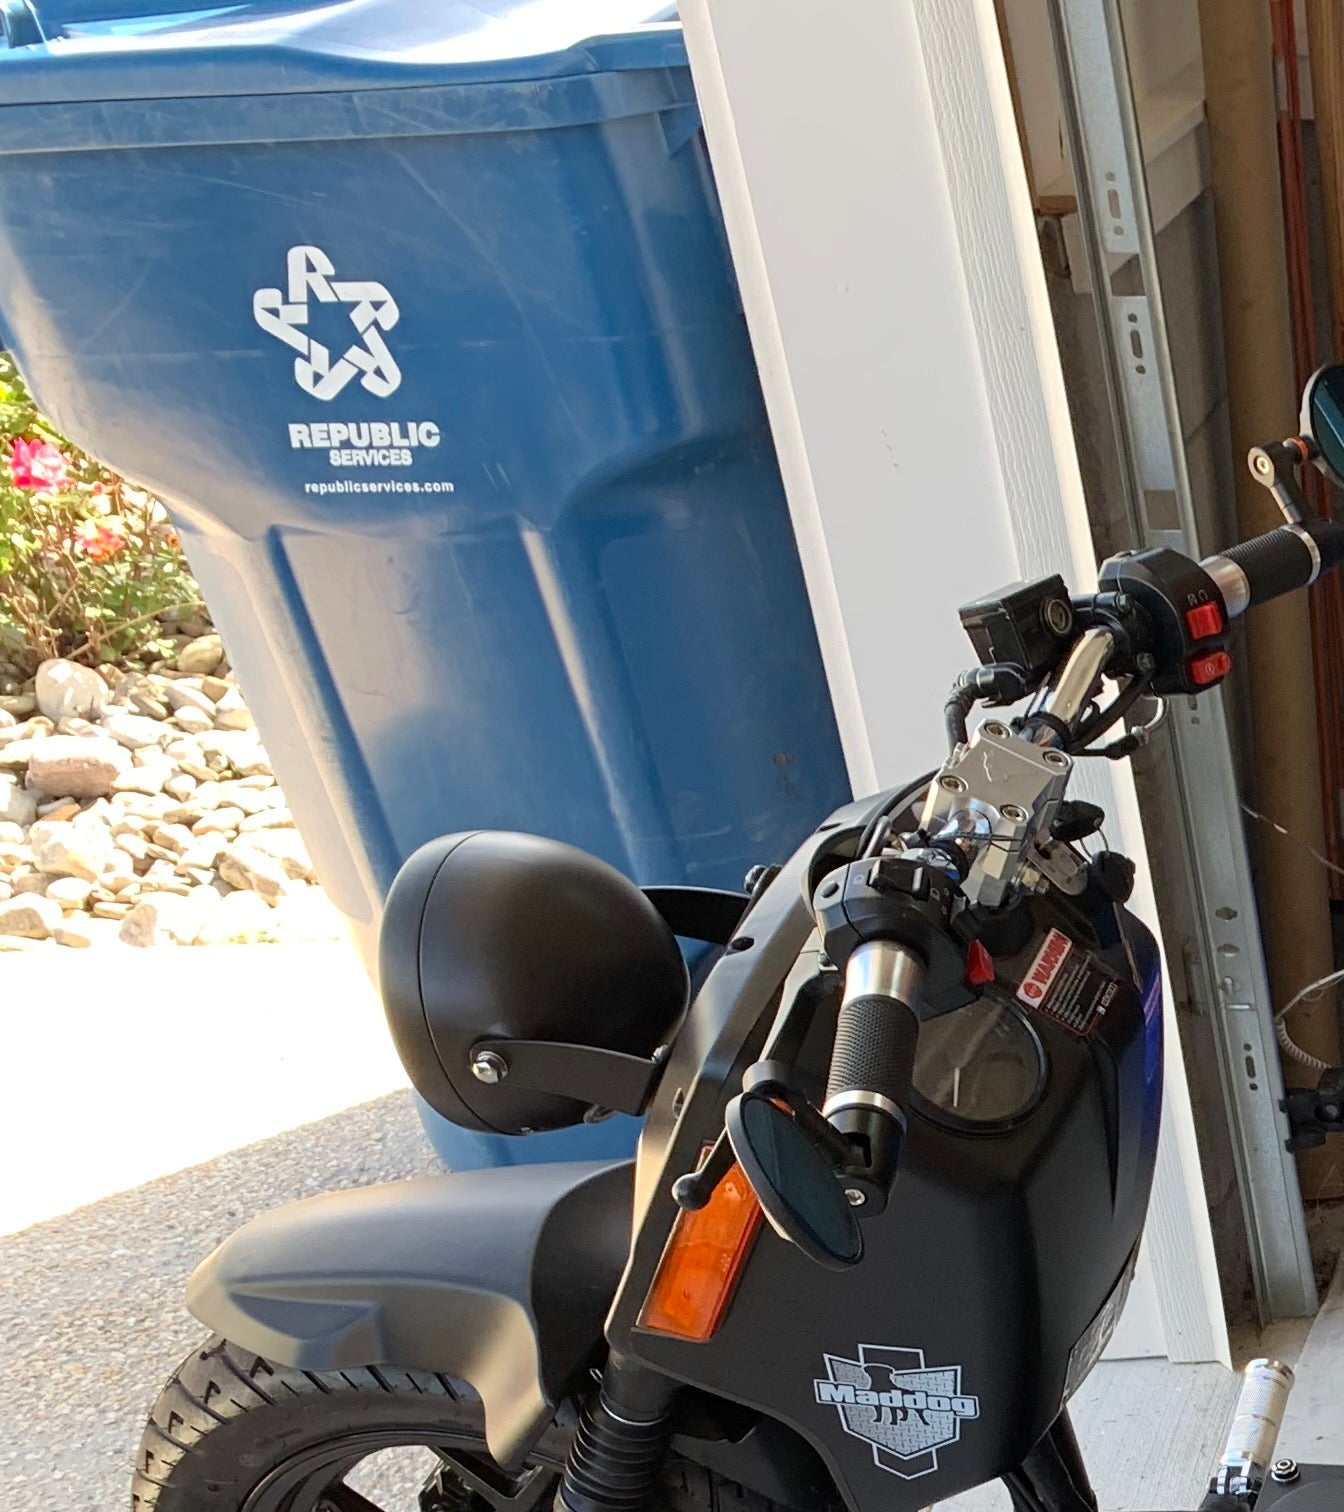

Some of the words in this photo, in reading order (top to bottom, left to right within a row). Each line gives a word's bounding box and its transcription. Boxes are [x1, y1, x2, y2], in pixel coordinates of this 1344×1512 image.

[288, 421, 441, 448] REPUBLIC
[328, 448, 413, 467] SERVICES
[304, 479, 455, 495] republicservices.com
[817, 1382, 977, 1417] Maddog
